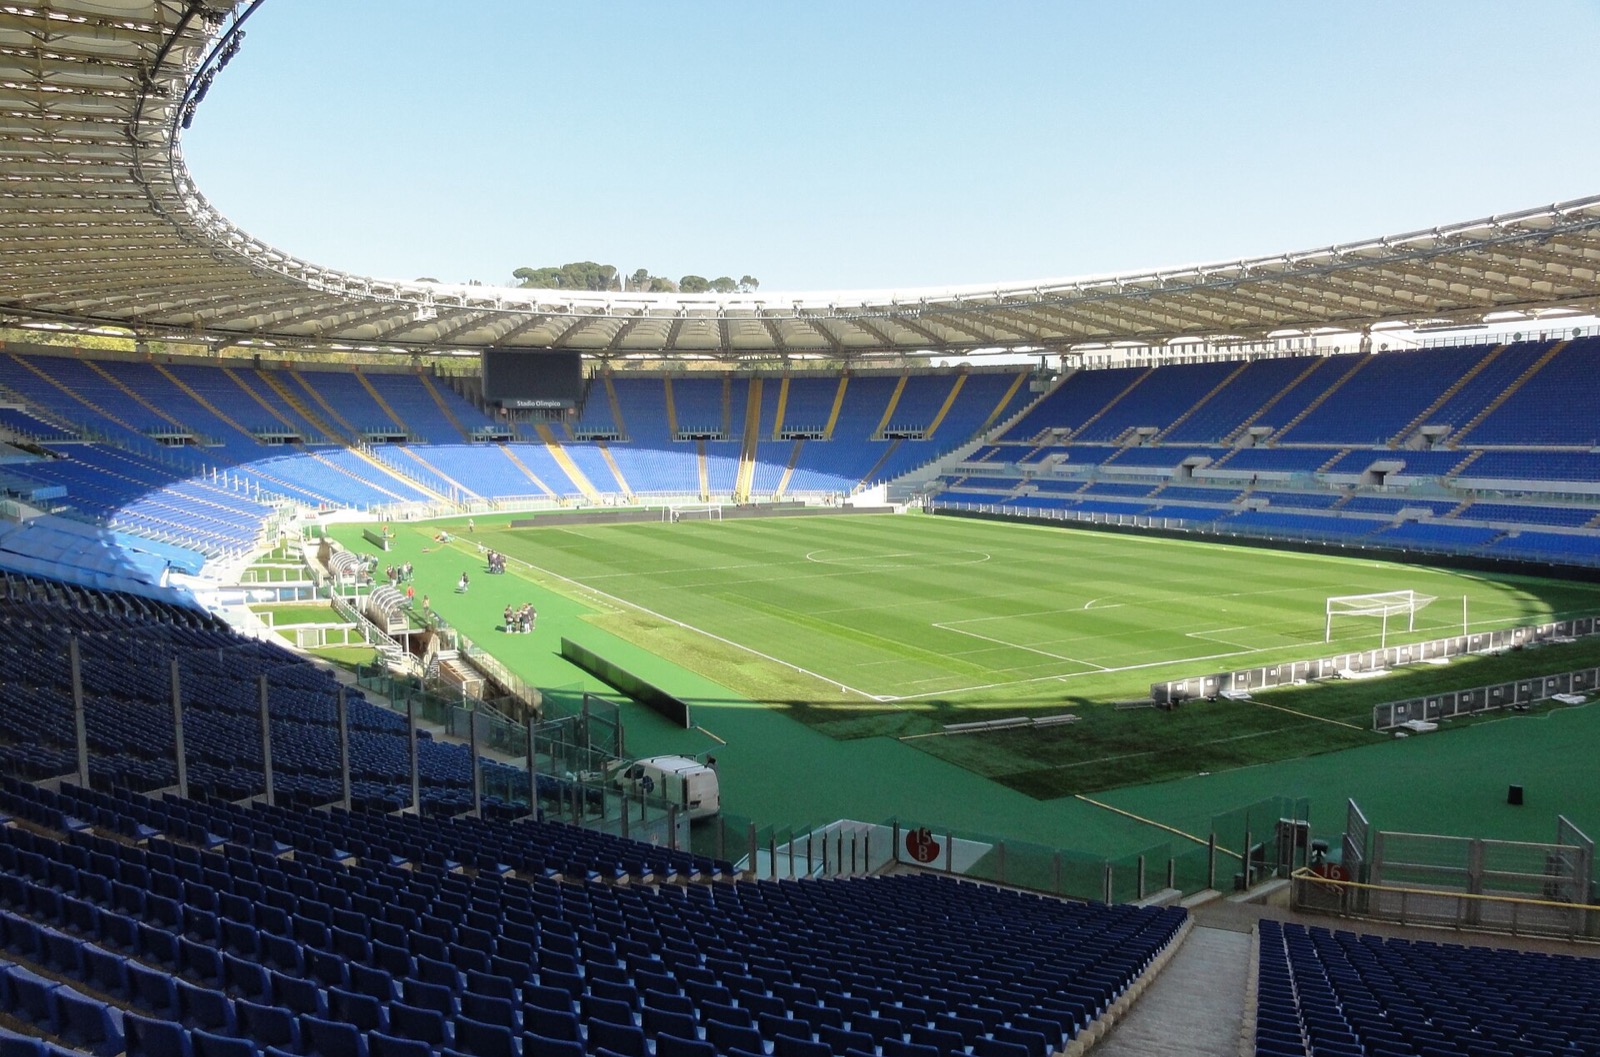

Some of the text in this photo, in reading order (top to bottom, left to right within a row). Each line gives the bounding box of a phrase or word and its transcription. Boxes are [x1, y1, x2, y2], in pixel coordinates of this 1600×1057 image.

[916, 829, 931, 845] 15
[918, 845, 928, 861] B
[1322, 863, 1341, 879] 16
